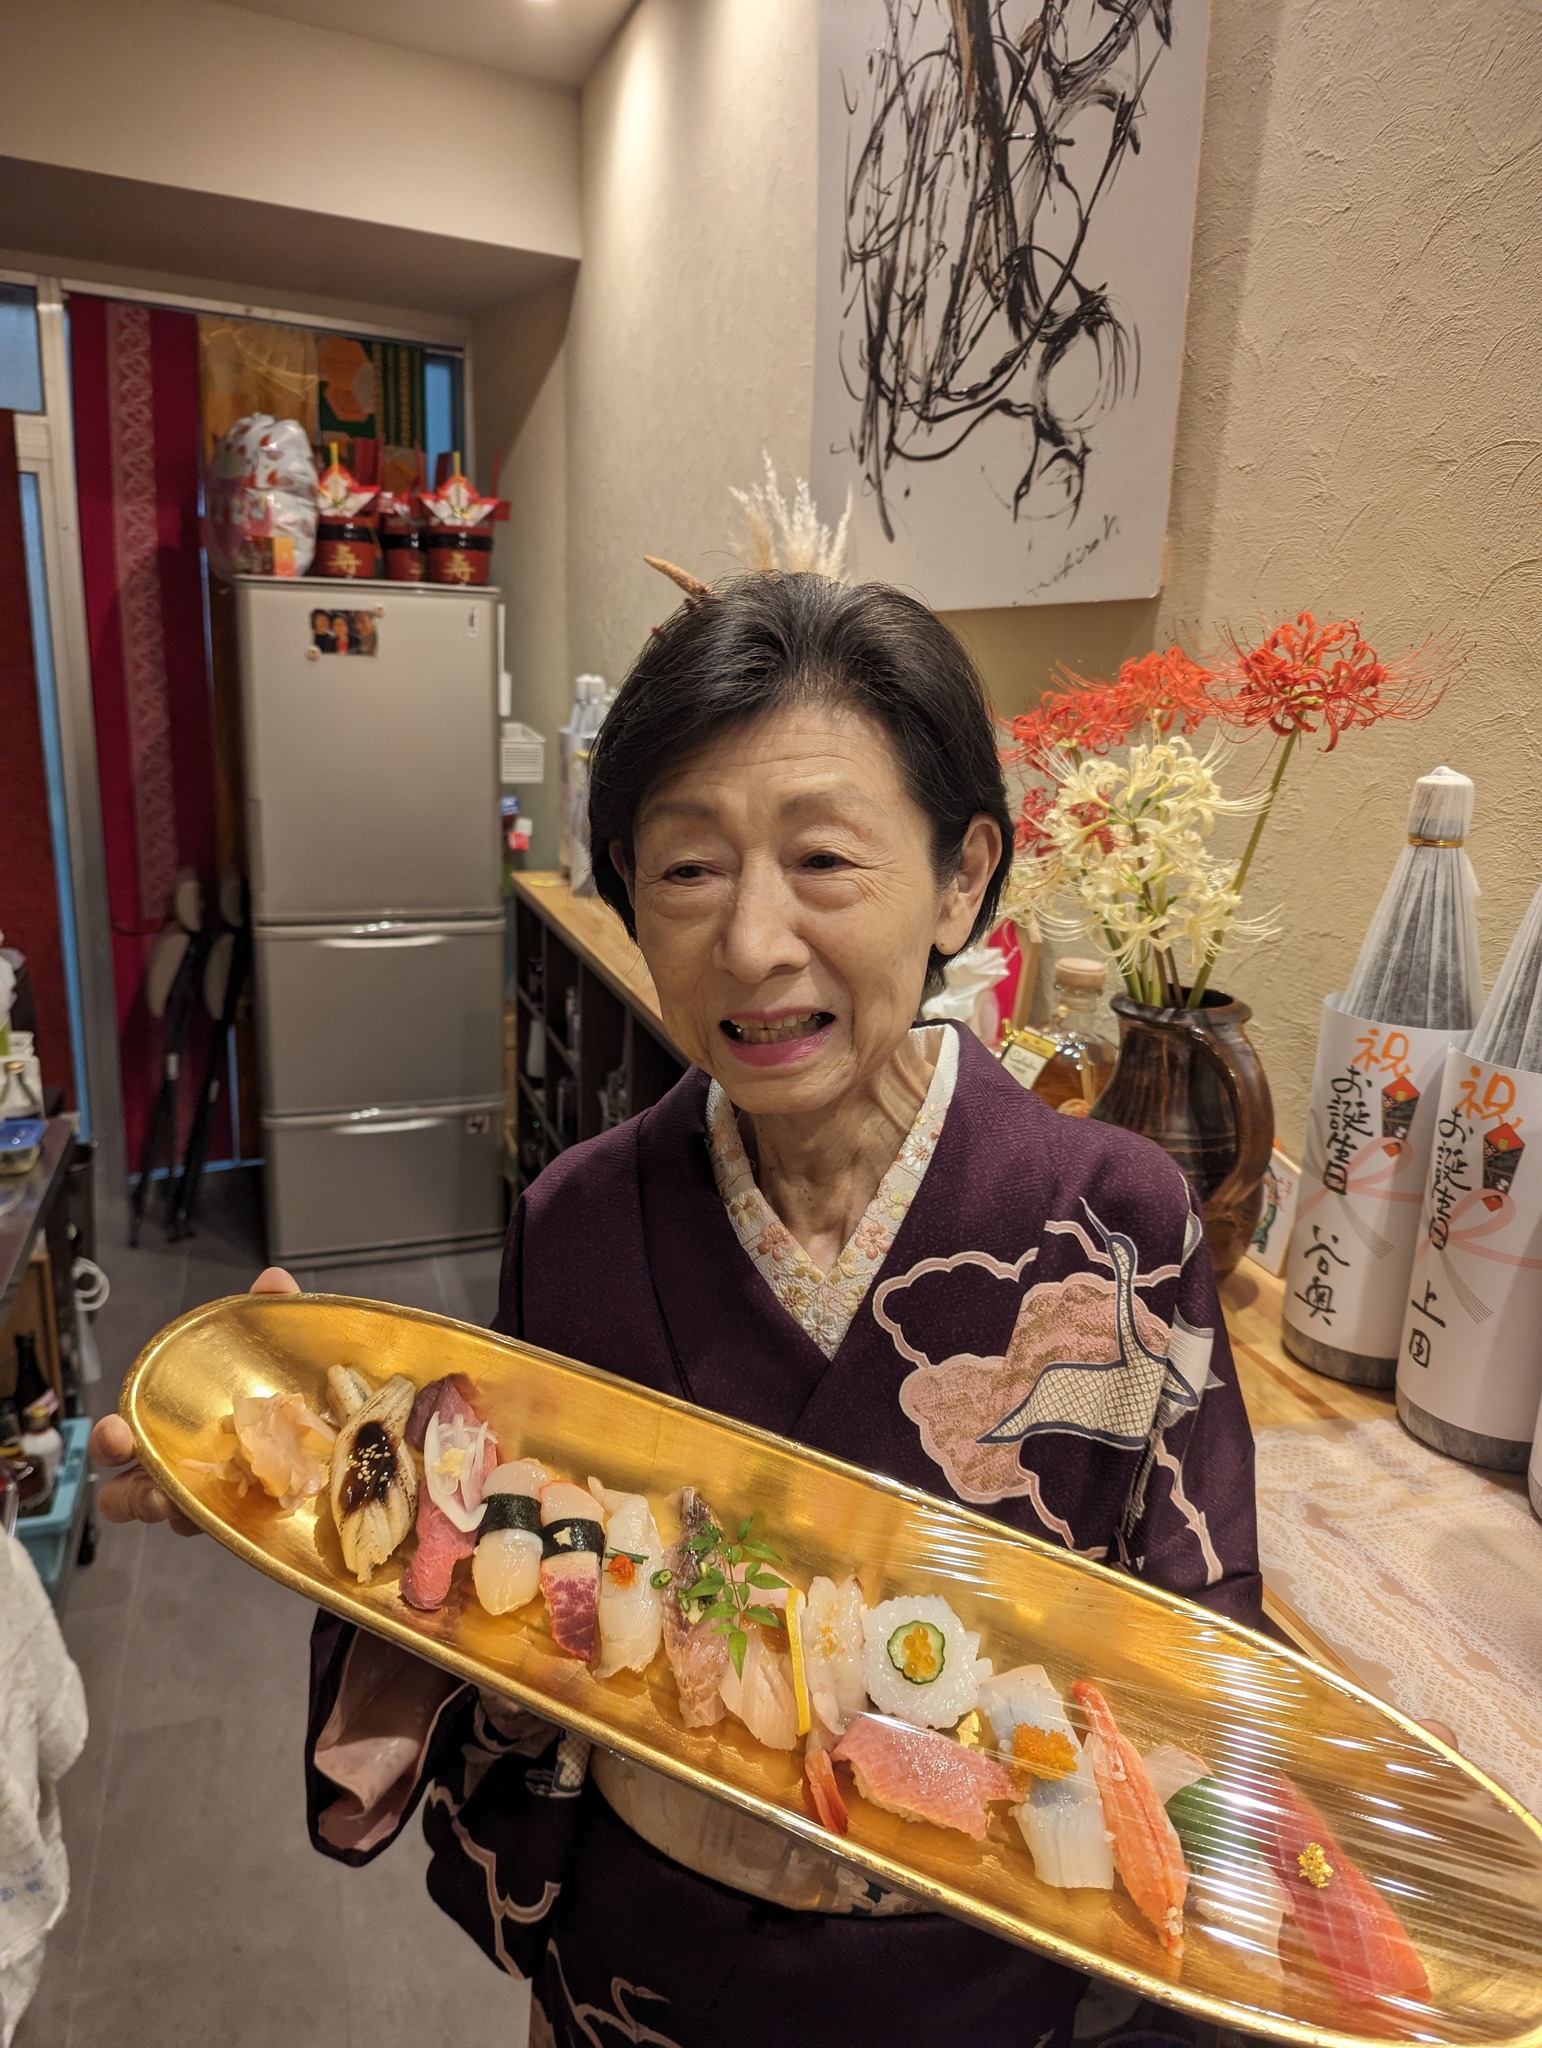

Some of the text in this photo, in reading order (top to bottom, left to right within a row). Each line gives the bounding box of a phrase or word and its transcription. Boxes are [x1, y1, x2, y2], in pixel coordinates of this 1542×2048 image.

[1351, 1028, 1413, 1079] 祝
[1455, 1065, 1524, 1130] 祝
[1322, 1065, 1374, 1196] お誕生日
[1428, 1106, 1475, 1251] お誕生日
